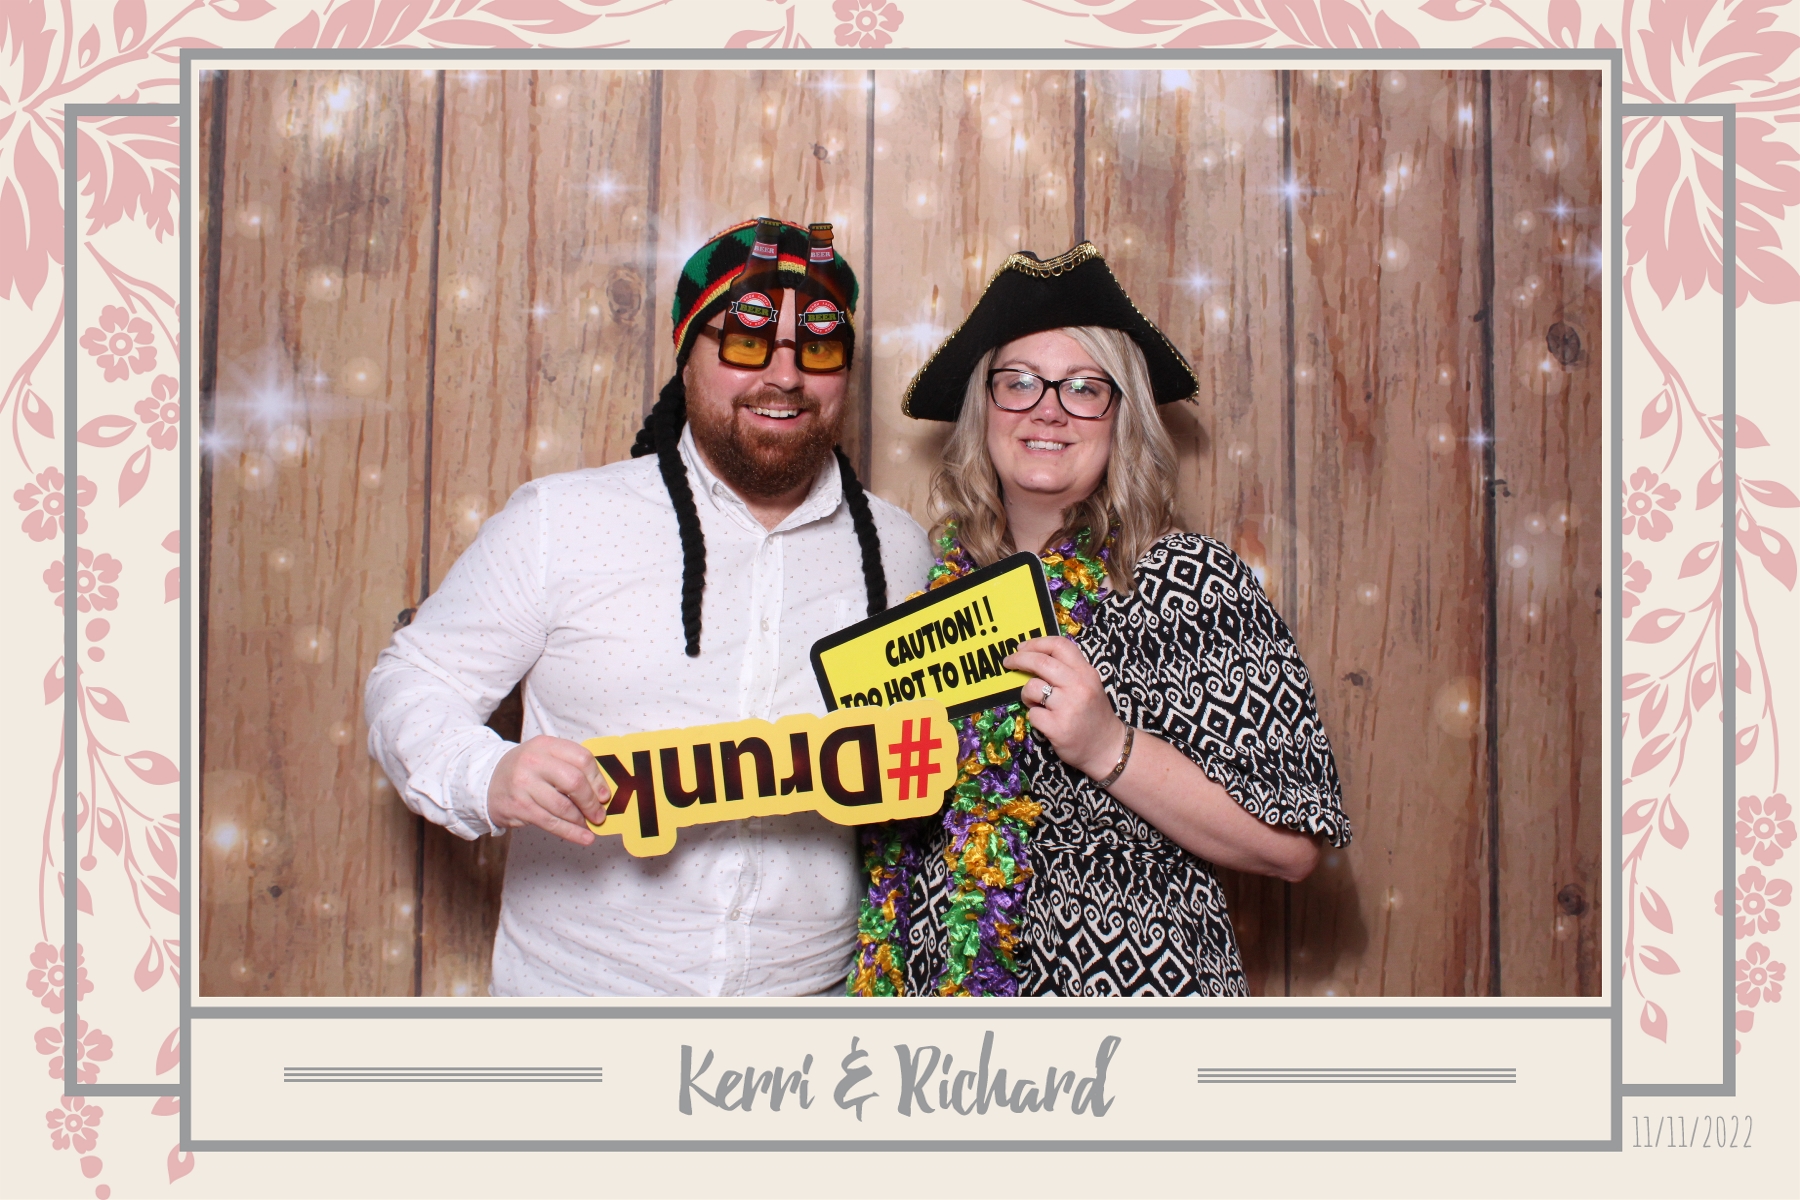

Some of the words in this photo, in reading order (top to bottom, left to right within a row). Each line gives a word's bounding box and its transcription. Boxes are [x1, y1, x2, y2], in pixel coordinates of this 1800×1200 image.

[754, 245, 775, 254] BEER
[740, 303, 769, 317] BEER
[808, 313, 836, 321] BEER
[885, 594, 999, 668] CAUTION!!
[884, 668, 927, 706] HOT
[927, 661, 960, 693] TO
[959, 627, 1043, 686] HAND
[594, 717, 943, 839] #Drunk
